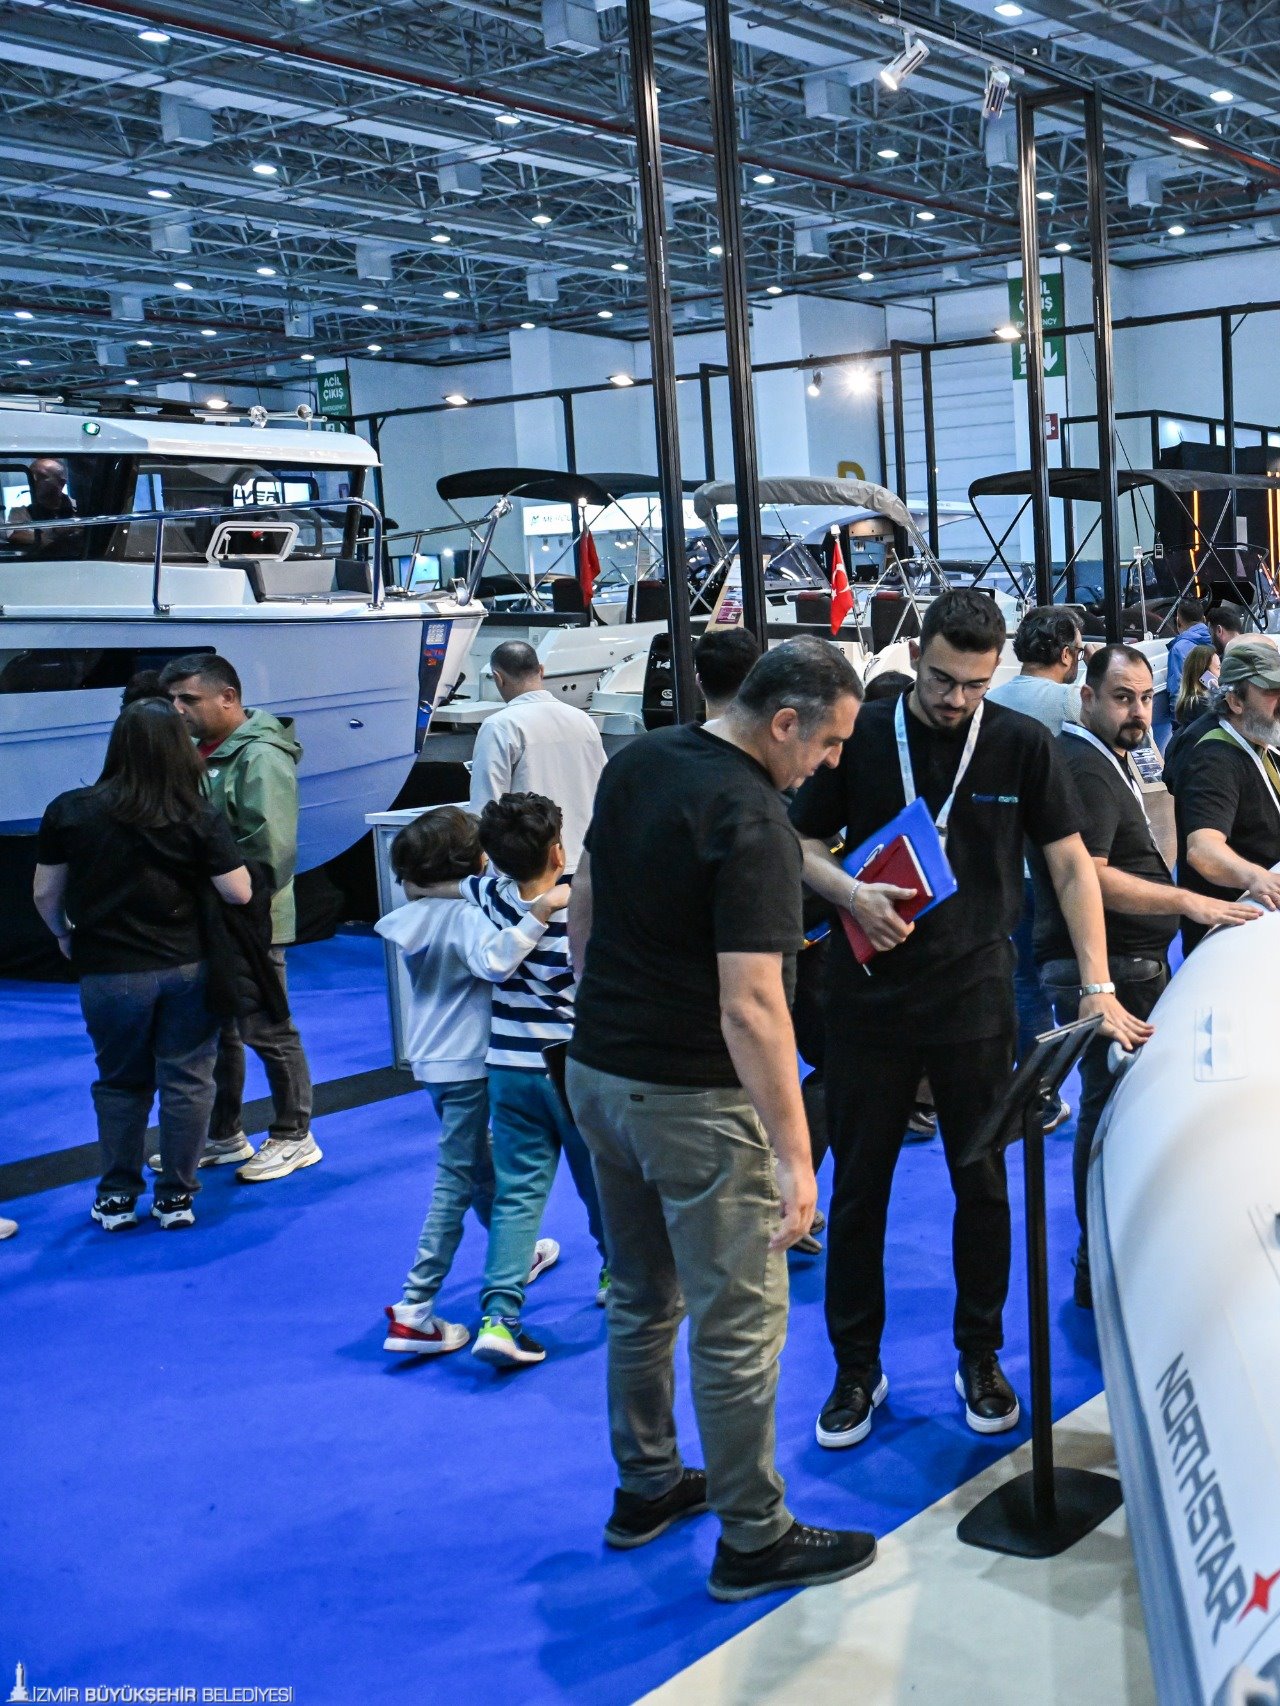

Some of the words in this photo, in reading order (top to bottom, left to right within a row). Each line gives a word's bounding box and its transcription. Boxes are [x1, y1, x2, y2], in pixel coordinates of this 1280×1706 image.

[1016, 318, 1057, 327] EMNCY
[323, 373, 341, 388] ACİL
[322, 388, 344, 402] ÇIKIŞ
[1155, 1351, 1248, 1647] NORTHSTAR
